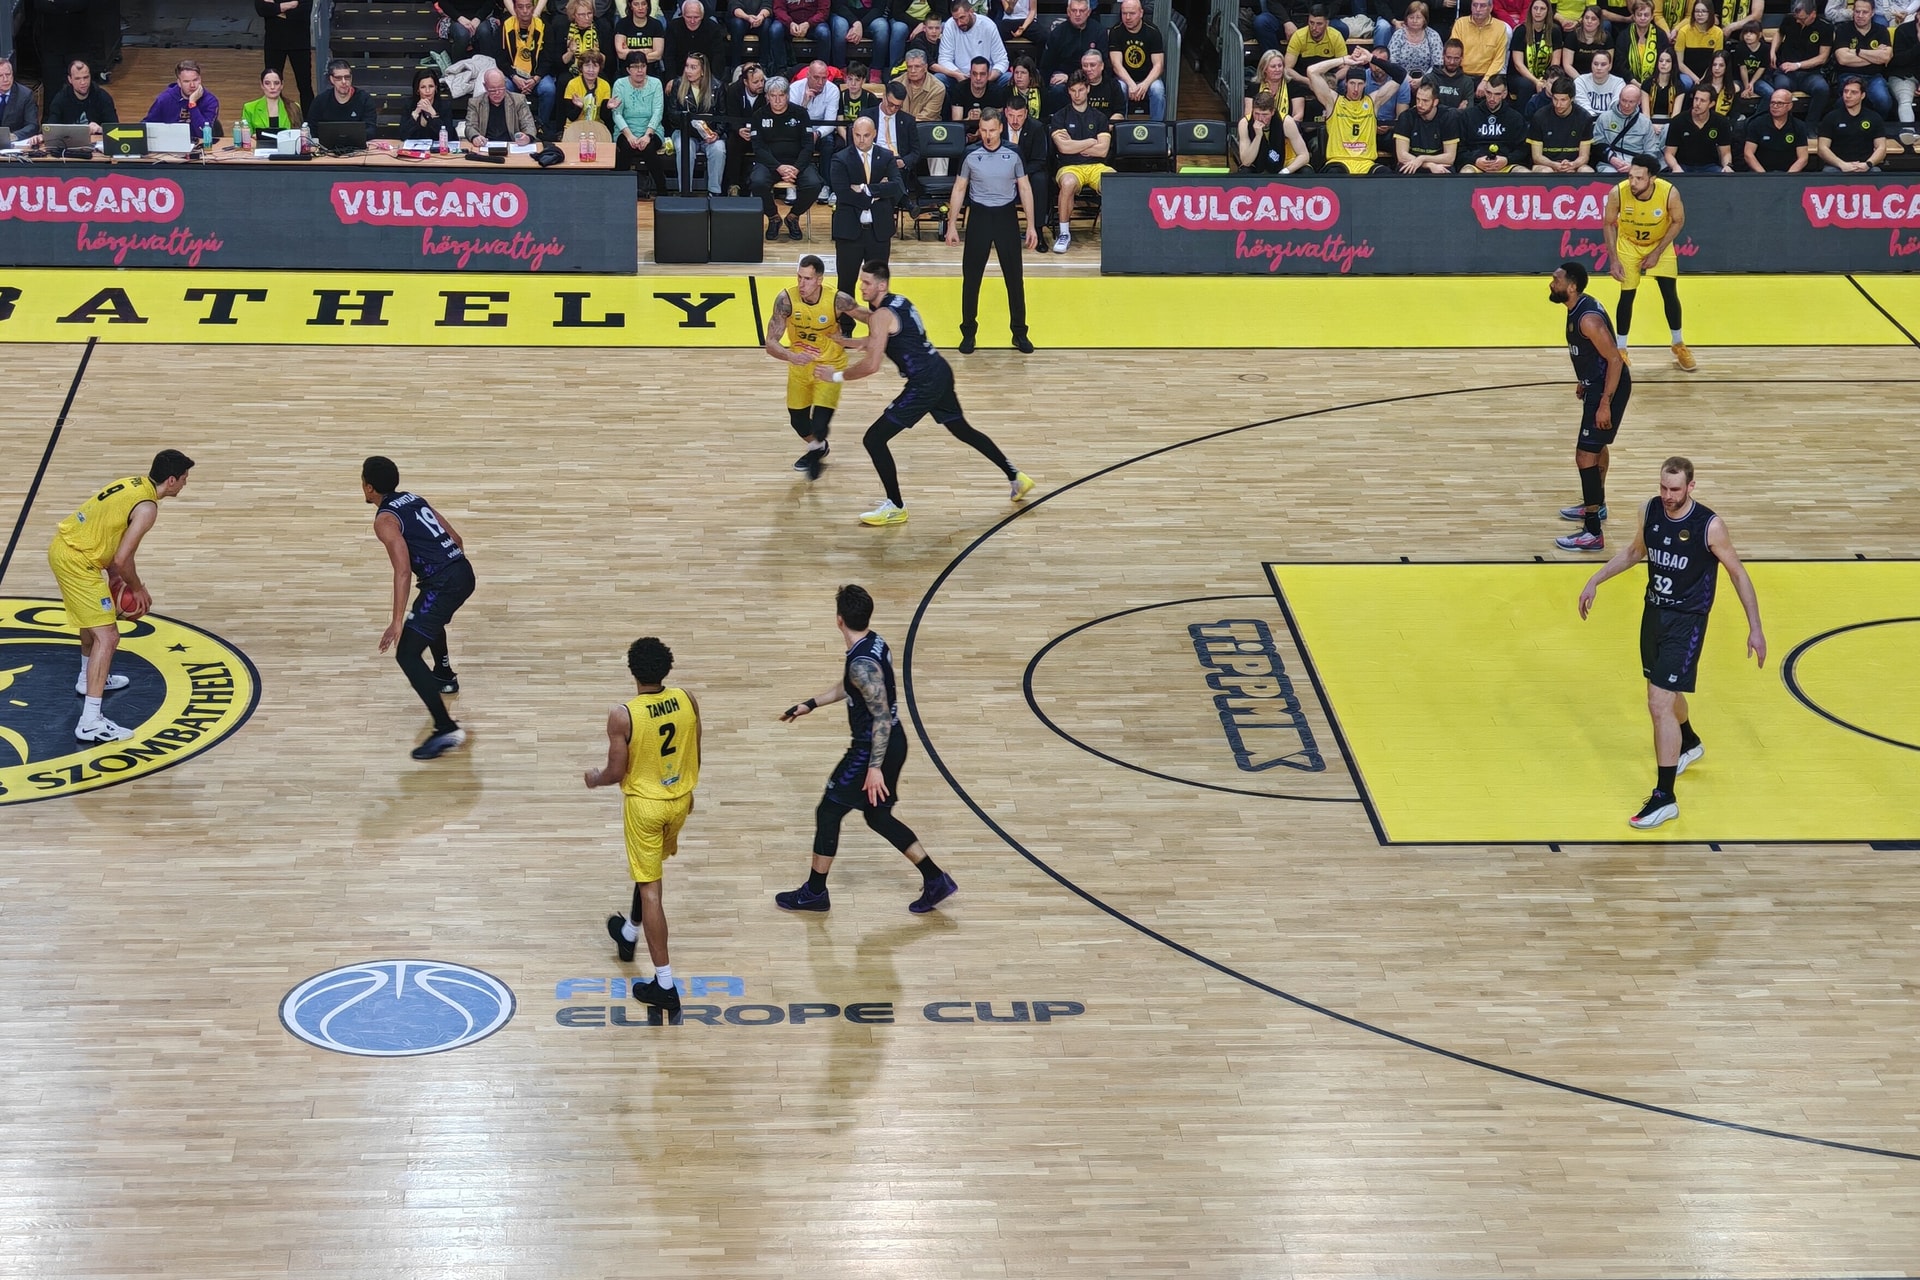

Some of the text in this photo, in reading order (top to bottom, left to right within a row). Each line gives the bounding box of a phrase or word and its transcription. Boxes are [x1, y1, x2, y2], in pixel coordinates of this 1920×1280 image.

[627, 37, 653, 47] FALCO
[762, 118, 774, 128] 007
[1352, 124, 1360, 136] 6
[0, 186, 175, 214] VULCANO
[338, 189, 519, 218] VULCANO
[1157, 194, 1331, 222] VULCANO
[1480, 194, 1608, 221] VULCA
[1635, 230, 1651, 241] 12
[97, 483, 125, 502] 9
[414, 506, 446, 538] 19
[1648, 547, 1689, 570] BILBAO
[1653, 573, 1673, 595] 32
[645, 696, 681, 719] TANOH
[27, 661, 235, 790] SZOMBATHELY
[658, 722, 677, 757] 2
[556, 1001, 1085, 1027] EUROPE CUP
